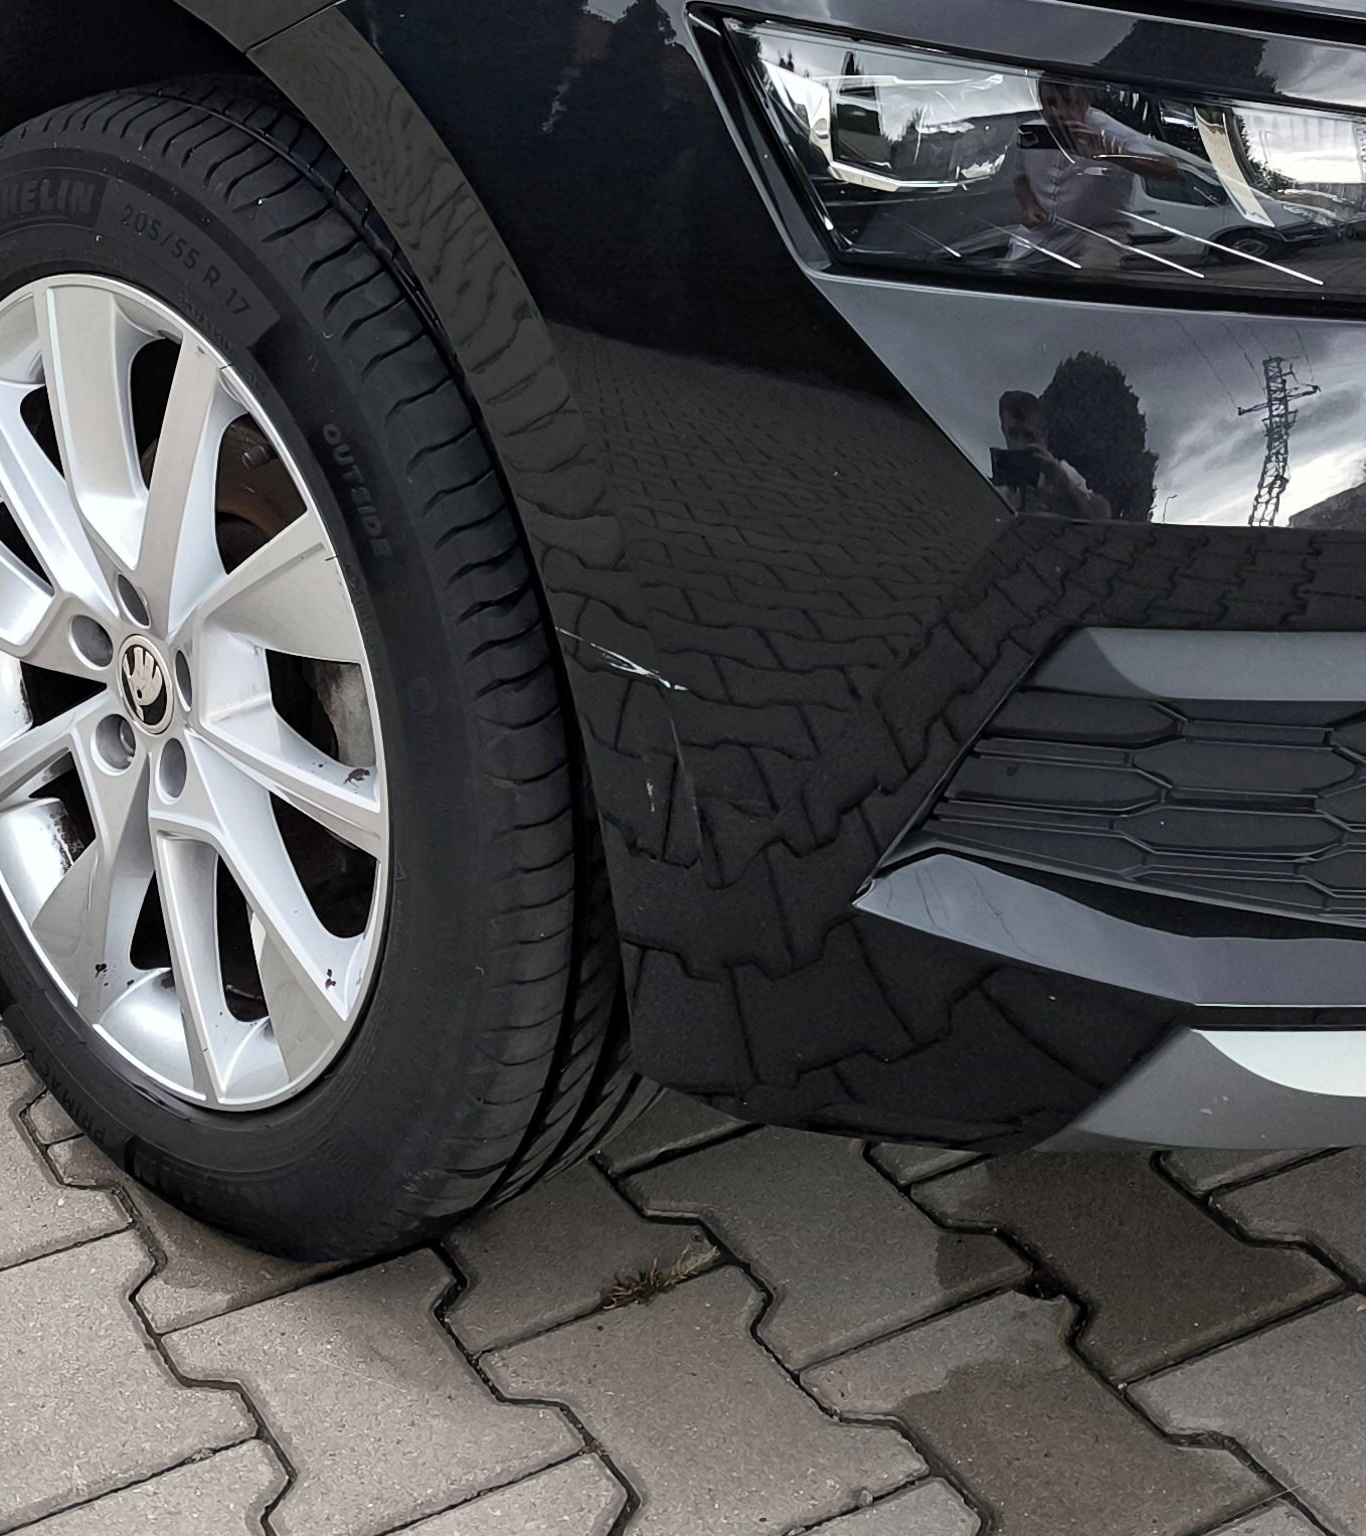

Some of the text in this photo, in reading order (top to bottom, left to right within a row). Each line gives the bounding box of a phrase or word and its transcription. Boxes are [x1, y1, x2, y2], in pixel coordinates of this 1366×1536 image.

[121, 204, 253, 318] 205/55 R 17
[323, 422, 393, 558] OUTSIDE
